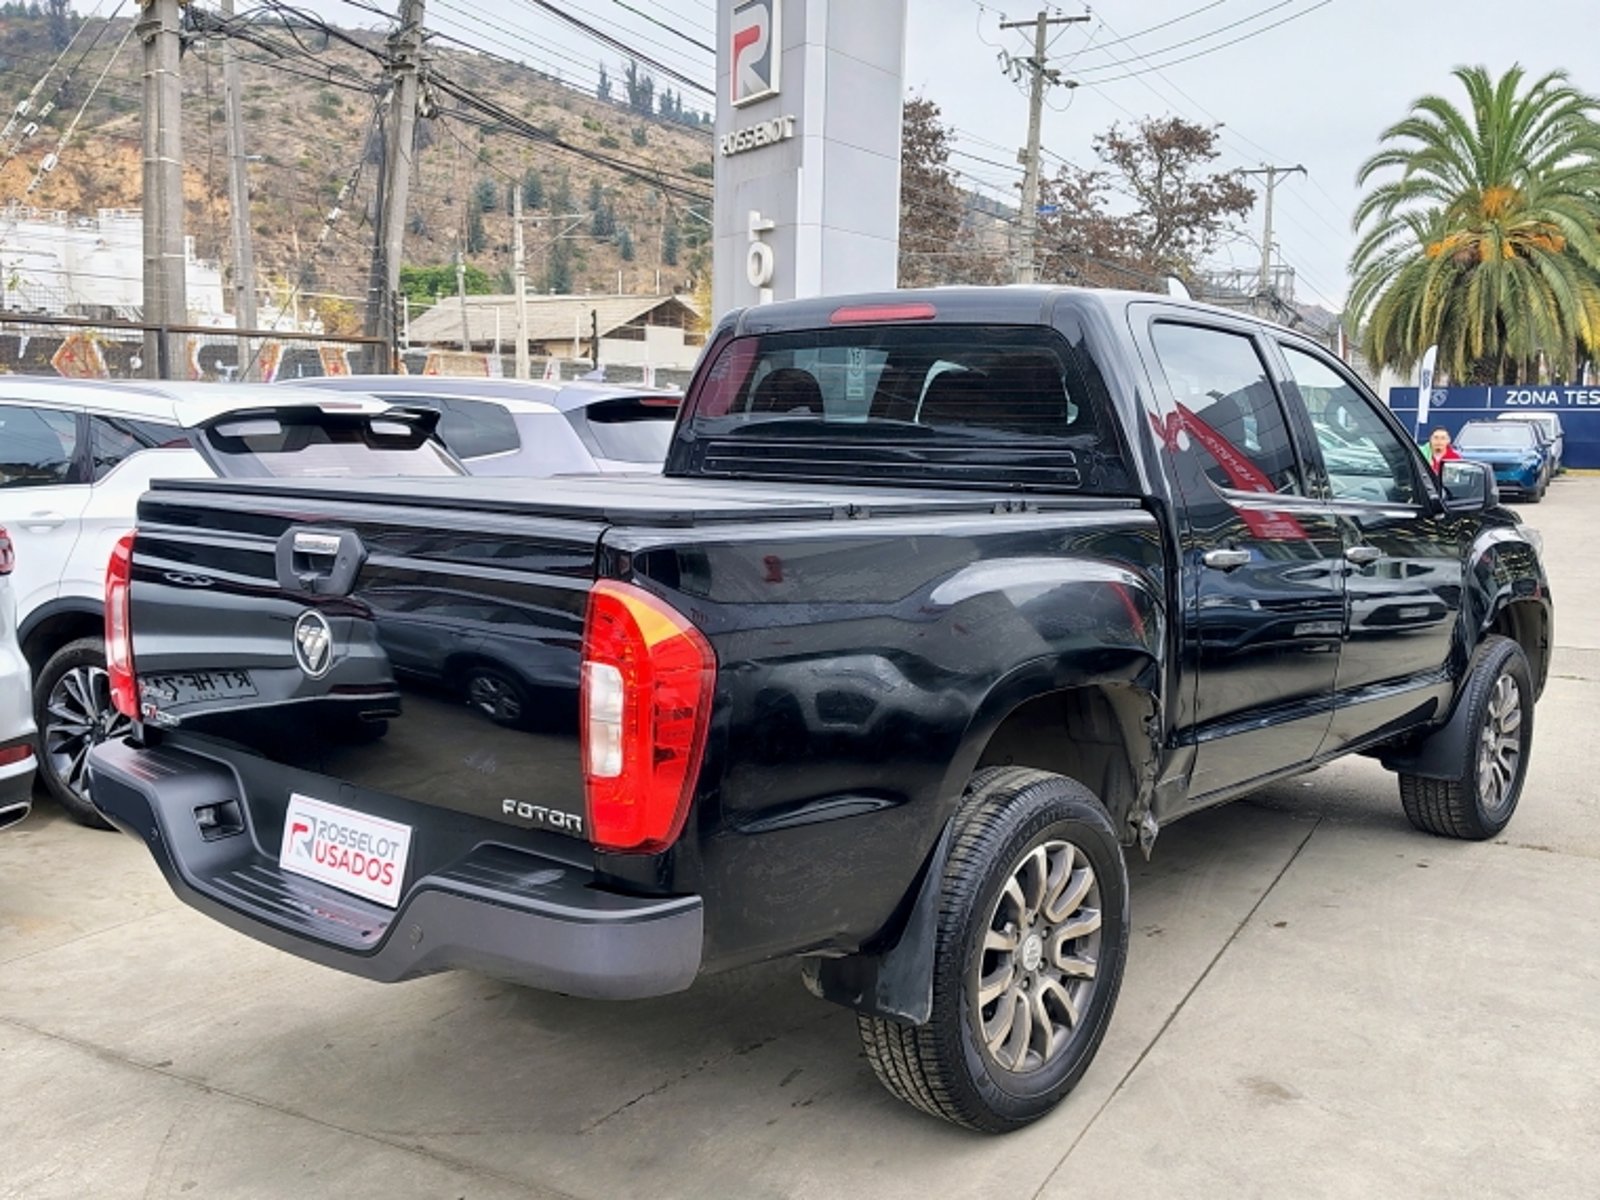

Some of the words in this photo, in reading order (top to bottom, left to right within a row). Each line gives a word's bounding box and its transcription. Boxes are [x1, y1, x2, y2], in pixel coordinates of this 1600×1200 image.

[1506, 390, 1558, 404] ZONA
[502, 799, 583, 832] FOTON
[317, 821, 400, 857] ROSSELOT
[315, 844, 396, 887] USADOS
